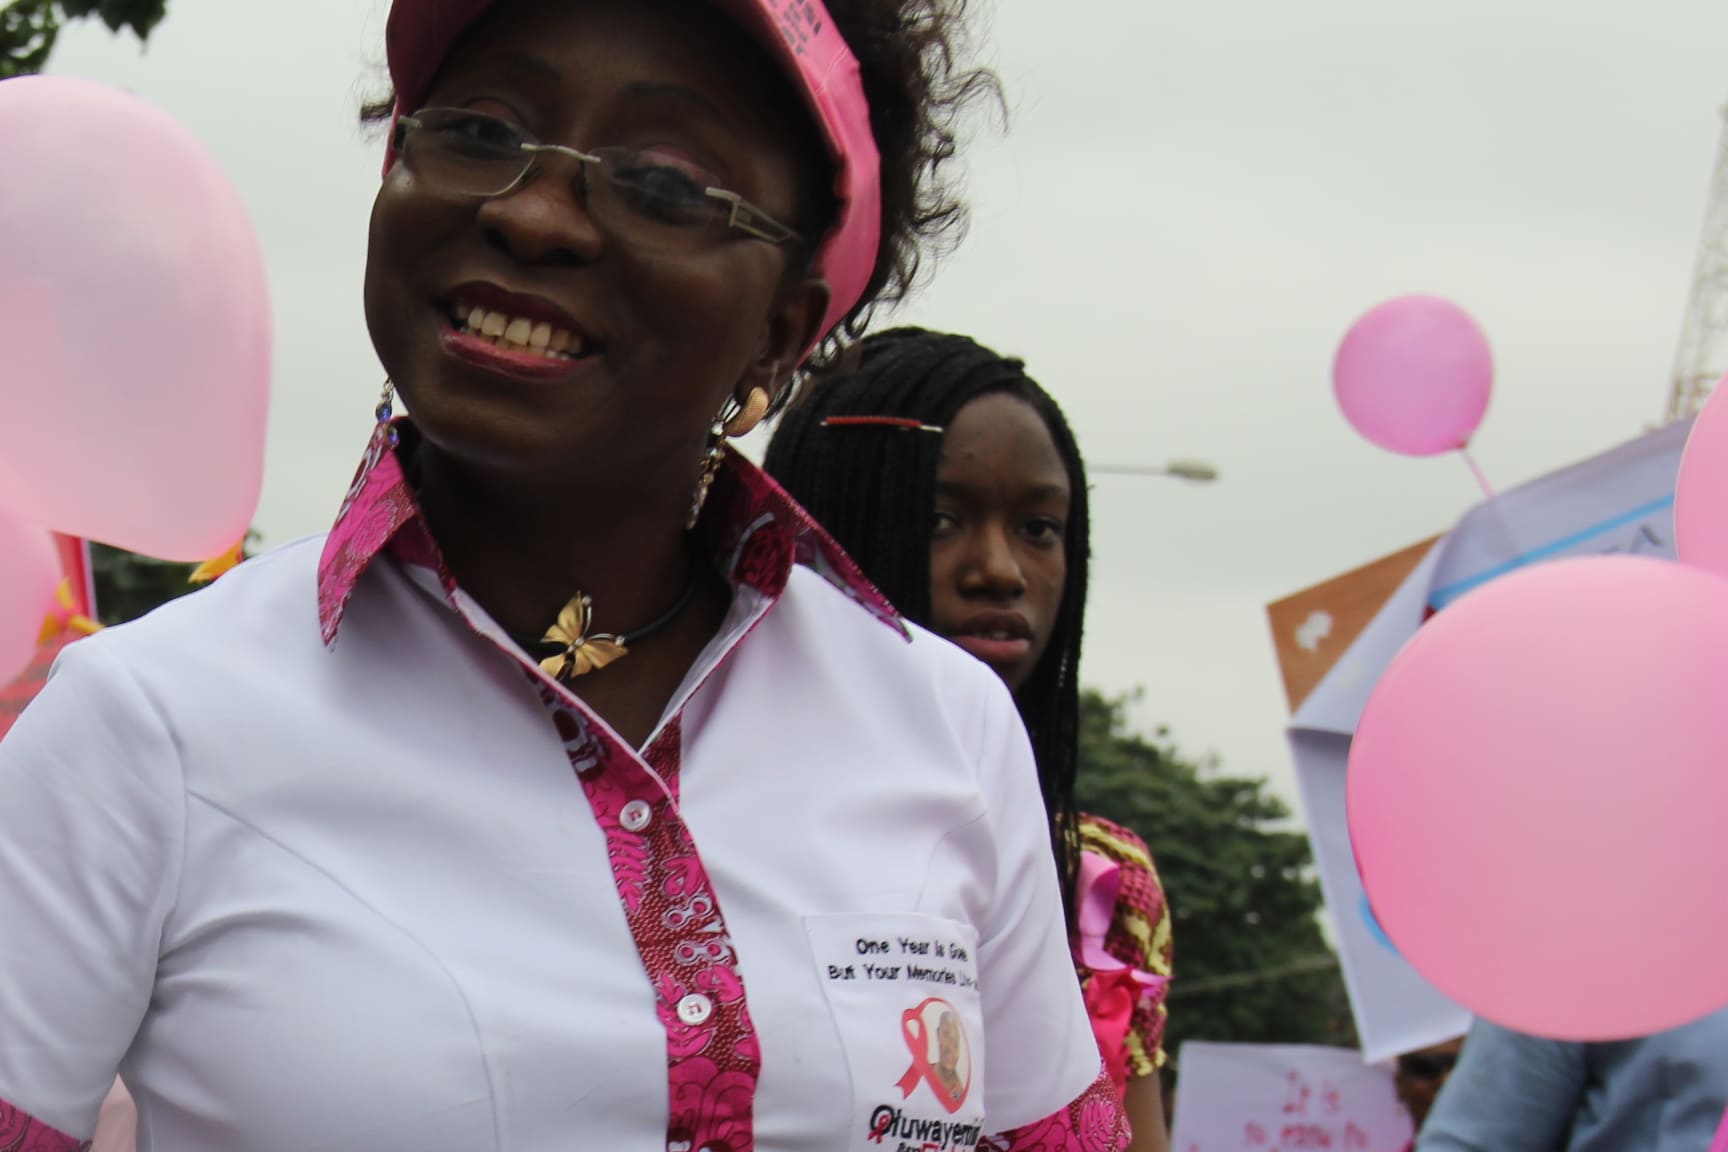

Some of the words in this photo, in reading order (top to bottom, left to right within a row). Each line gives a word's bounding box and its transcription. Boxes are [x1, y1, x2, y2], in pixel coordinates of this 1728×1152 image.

[856, 938, 889, 955] One
[897, 937, 930, 955] Year
[828, 965, 856, 980] But
[862, 963, 901, 980] Your
